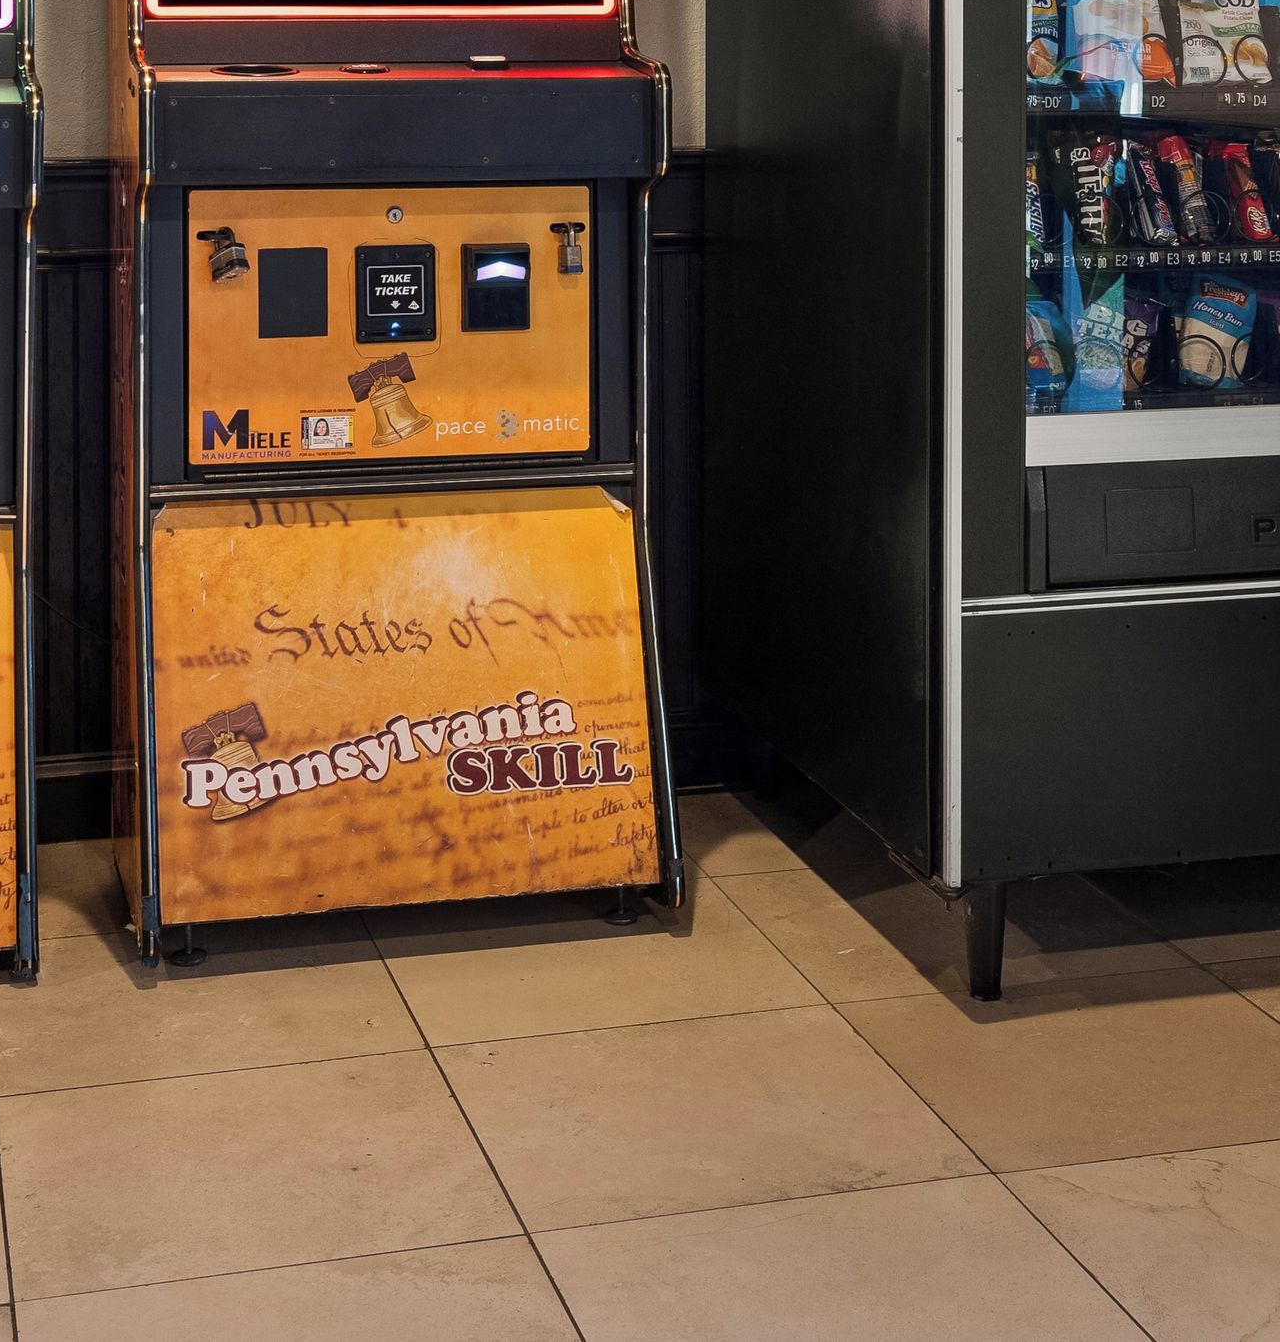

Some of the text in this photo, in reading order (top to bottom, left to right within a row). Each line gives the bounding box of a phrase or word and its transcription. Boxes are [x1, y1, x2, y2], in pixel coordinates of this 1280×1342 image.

[1184, 20, 1202, 30] 200
[1044, 96, 1059, 108] D0
[1151, 95, 1166, 108] D2
[1253, 94, 1268, 107] D4
[1063, 255, 1075, 268] E1
[1083, 254, 1128, 269] $2.00 E2
[1136, 251, 1180, 268] $2.00 E3
[1187, 251, 1231, 265] $2.00 E4
[1240, 249, 1262, 264] $2.00
[381, 273, 412, 283] TAKE
[375, 286, 418, 296] TICKET
[1203, 282, 1247, 302] Freshley's
[1087, 303, 1150, 337] BIG
[1193, 301, 1243, 328] Honey Bun
[202, 409, 292, 451] MIELE
[435, 413, 580, 442] pace matic
[202, 450, 292, 461] MANUFACTURING
[252, 603, 433, 665] States
[448, 596, 500, 668] of
[182, 689, 576, 810] Pennsylvania
[446, 737, 634, 796] SKILL
